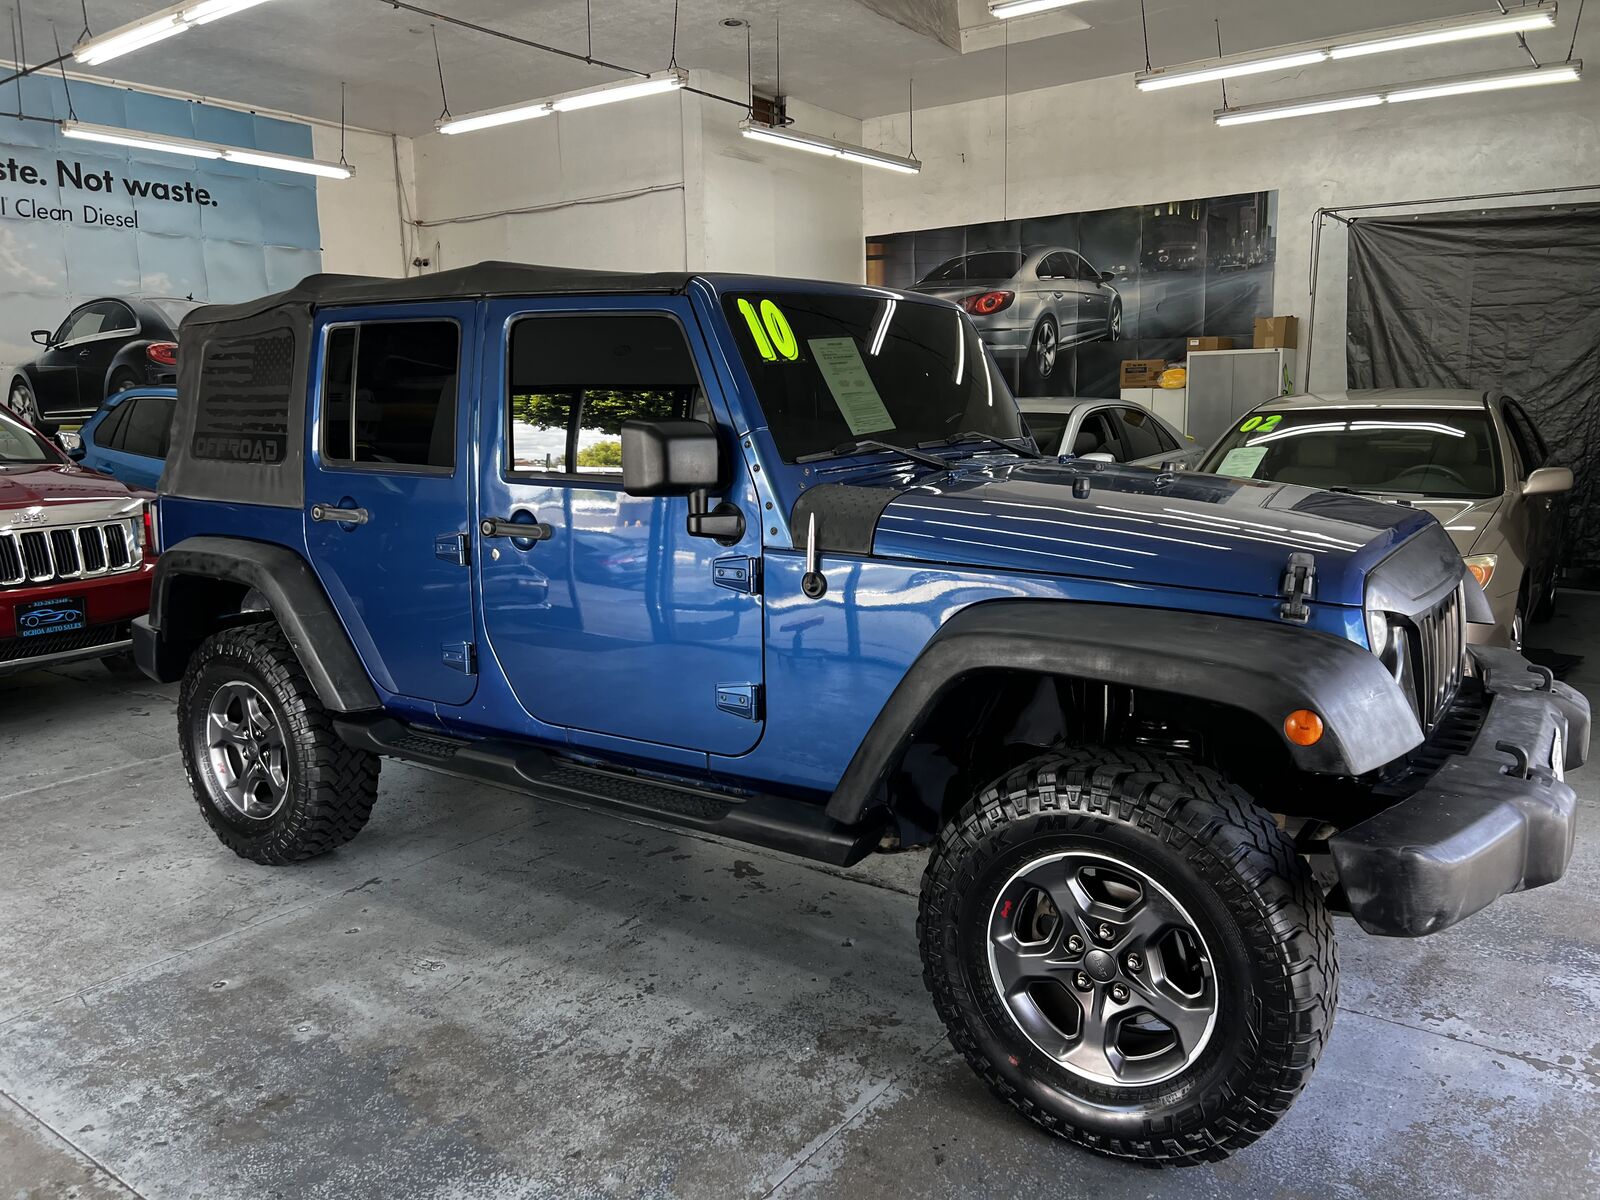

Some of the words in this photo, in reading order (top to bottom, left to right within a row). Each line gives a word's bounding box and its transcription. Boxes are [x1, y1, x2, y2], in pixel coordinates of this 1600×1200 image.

[56, 159, 114, 193] Not
[122, 177, 219, 207] waste.
[15, 198, 73, 222] Clean
[83, 205, 139, 228] Diesel
[737, 298, 799, 361] 10
[1239, 414, 1283, 433] 02
[11, 512, 49, 525] Jeep
[23, 628, 46, 637] OCHOA
[46, 625, 63, 634] AUTO
[63, 622, 82, 631] SALES
